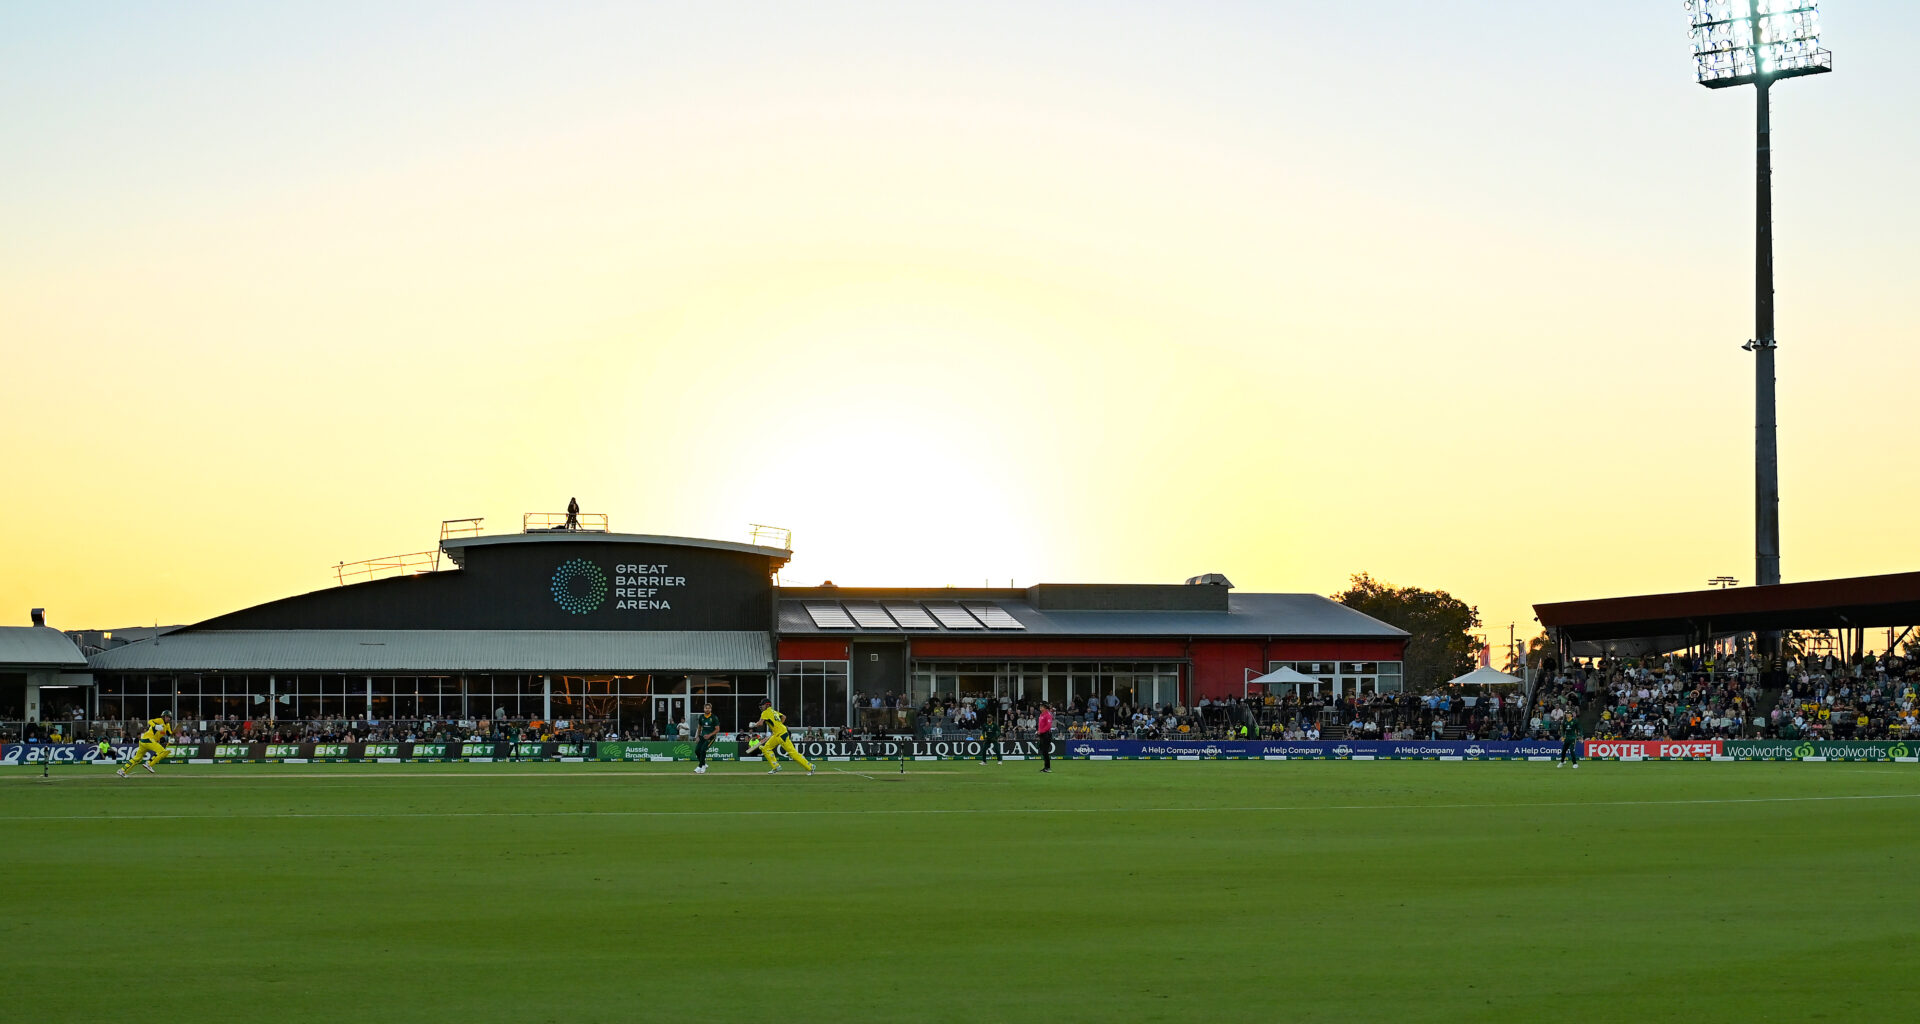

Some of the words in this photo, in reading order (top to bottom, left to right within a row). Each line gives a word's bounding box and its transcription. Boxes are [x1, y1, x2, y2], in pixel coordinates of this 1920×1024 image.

[616, 564, 668, 574] GREAT
[616, 576, 686, 586] BARRIER
[616, 588, 658, 598] REEF
[616, 600, 671, 610] ARENA
[26, 746, 75, 760] asics
[166, 747, 199, 755] BKT
[215, 747, 248, 755] BKT
[314, 746, 347, 754] BKT
[364, 746, 397, 754] BKT
[413, 746, 445, 754] BKT
[462, 746, 494, 754] BKT
[1148, 746, 1165, 755] Help
[1166, 746, 1200, 755] Company
[1270, 747, 1287, 755] Help
[1288, 747, 1323, 755] Company
[1401, 746, 1419, 755] Help
[1420, 746, 1455, 755] Company
[1521, 747, 1539, 755] Help
[1588, 744, 1650, 757] FOXTEL
[1727, 745, 1793, 757] Woolworths
[1820, 745, 1887, 757] Woolworths
